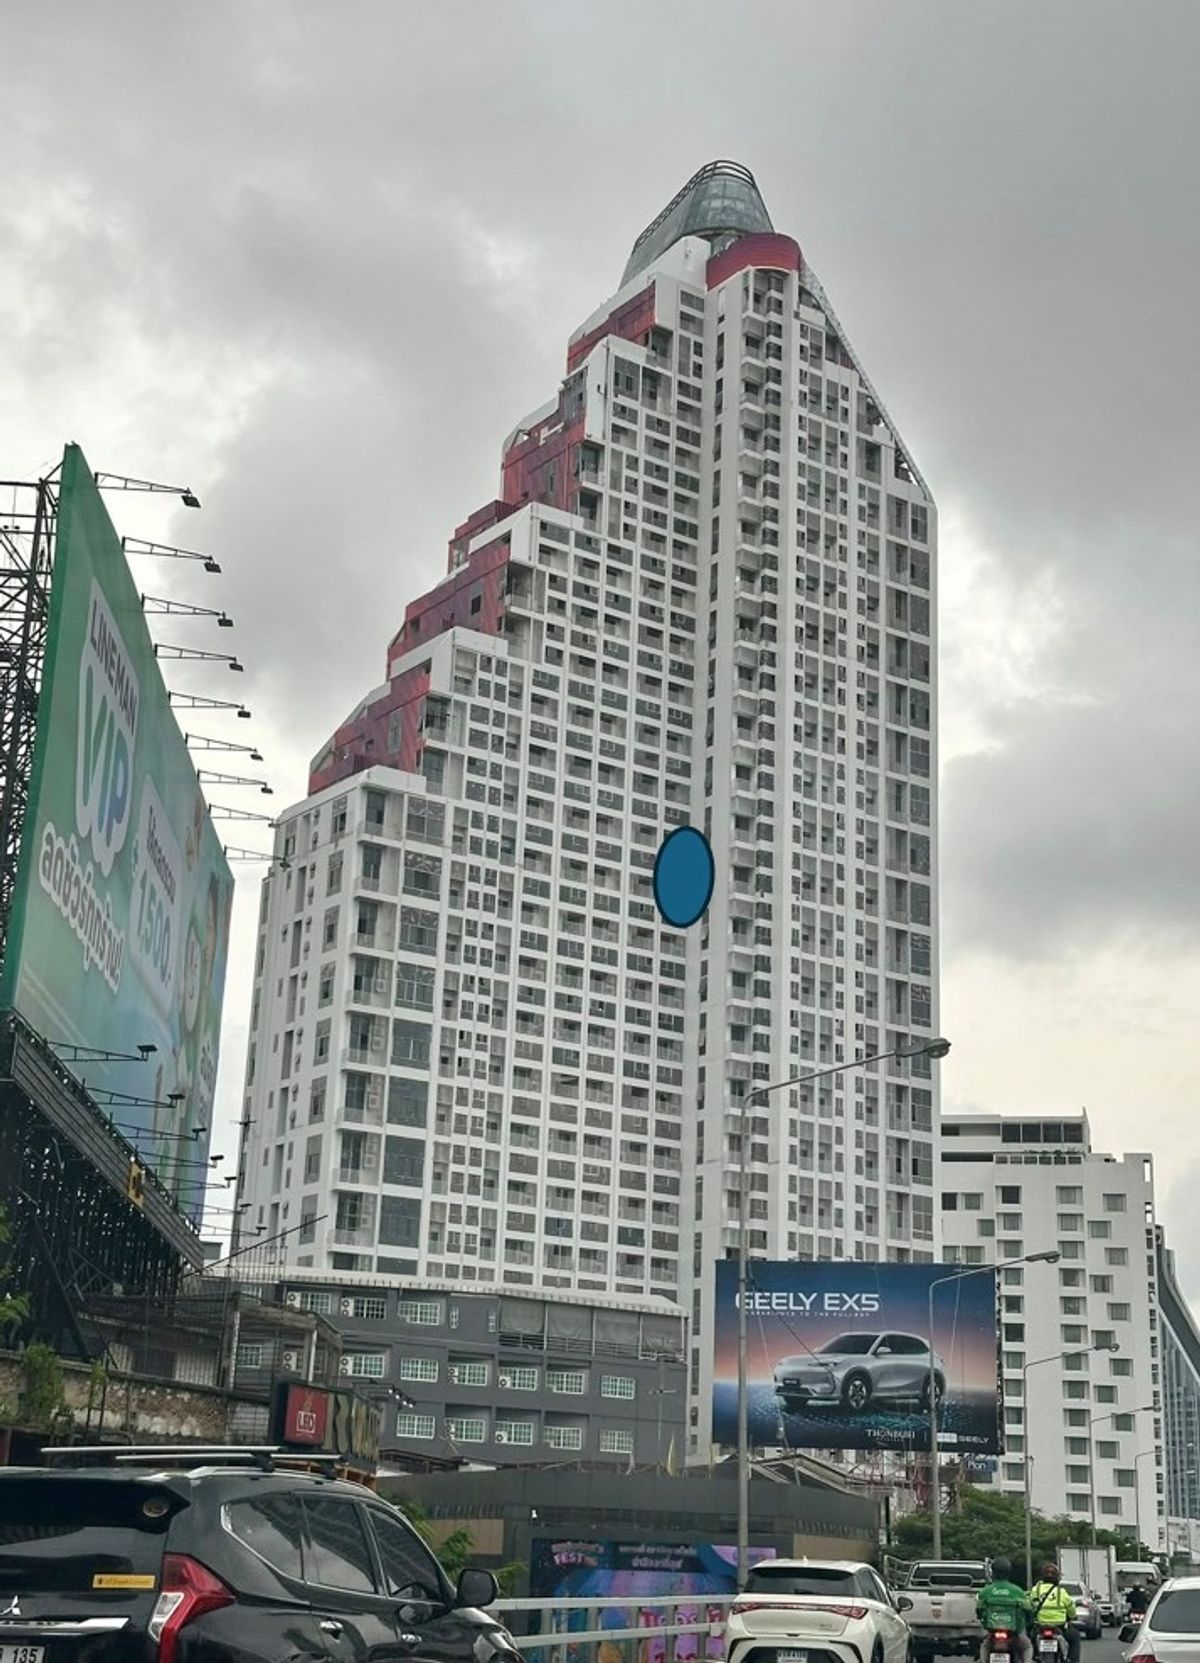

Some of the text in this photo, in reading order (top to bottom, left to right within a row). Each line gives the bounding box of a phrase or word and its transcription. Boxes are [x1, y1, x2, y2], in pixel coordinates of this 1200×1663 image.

[81, 664, 129, 850] VIP
[735, 1292, 880, 1311] GEELY EX5
[13, 1648, 38, 1663] 135
